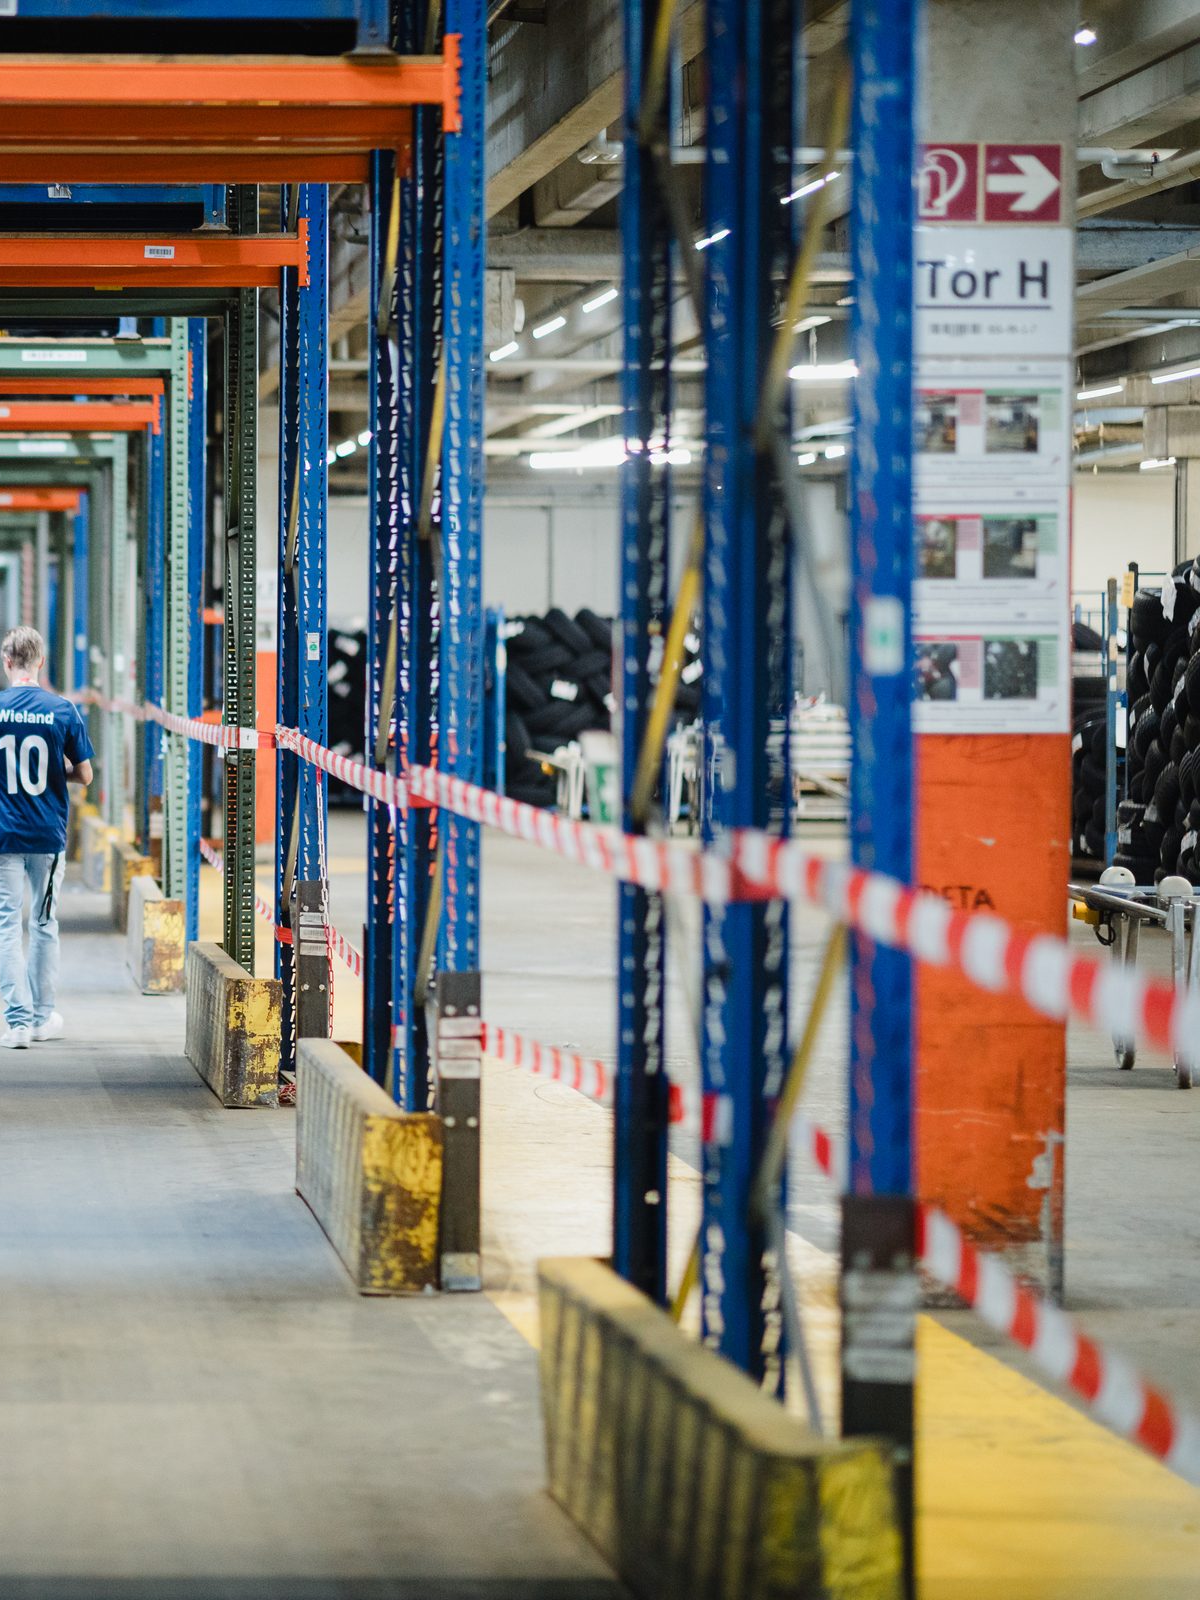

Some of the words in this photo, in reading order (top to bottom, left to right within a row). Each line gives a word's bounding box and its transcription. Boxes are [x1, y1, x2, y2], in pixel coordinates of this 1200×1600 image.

[917, 260, 1000, 299] Tor
[1018, 260, 1049, 299] H
[918, 885, 997, 910] ETA
